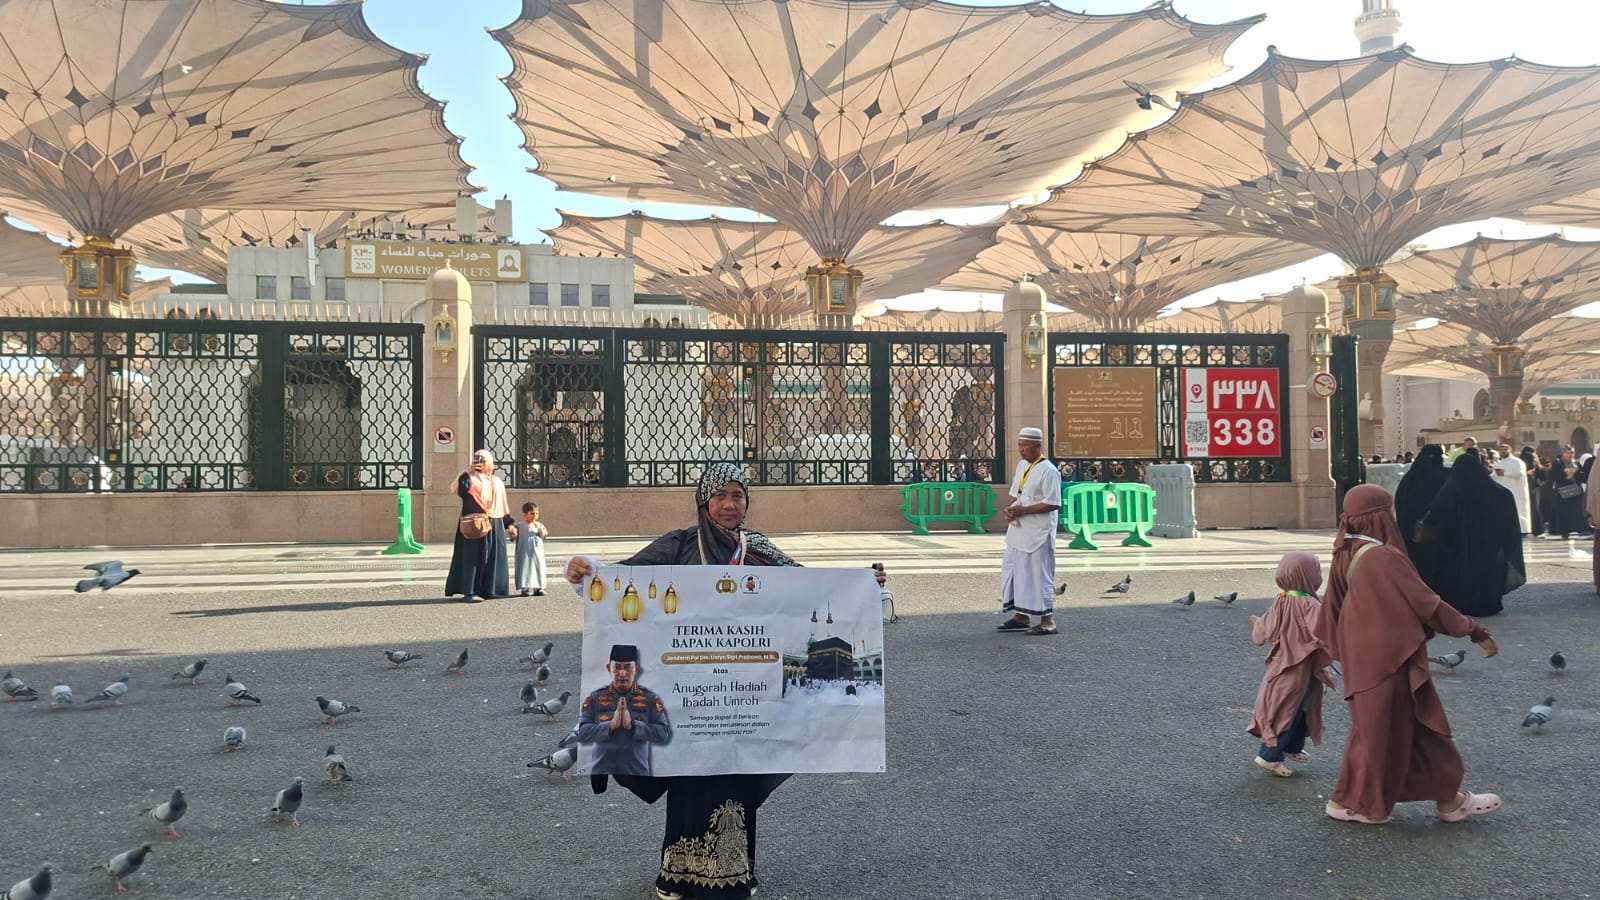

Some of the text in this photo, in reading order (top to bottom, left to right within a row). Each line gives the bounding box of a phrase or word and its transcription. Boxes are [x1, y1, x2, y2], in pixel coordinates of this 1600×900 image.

[381, 245, 491, 261] دورات مياه للنساء
[1212, 380, 1275, 409] ٣٣٨
[1214, 418, 1275, 446] 338
[674, 625, 765, 636] TERIMA KASIH
[672, 637, 771, 648] BAPAK KAPOLRI
[730, 681, 767, 692] Hadiah
[682, 695, 759, 708] Ibadah Umroh
